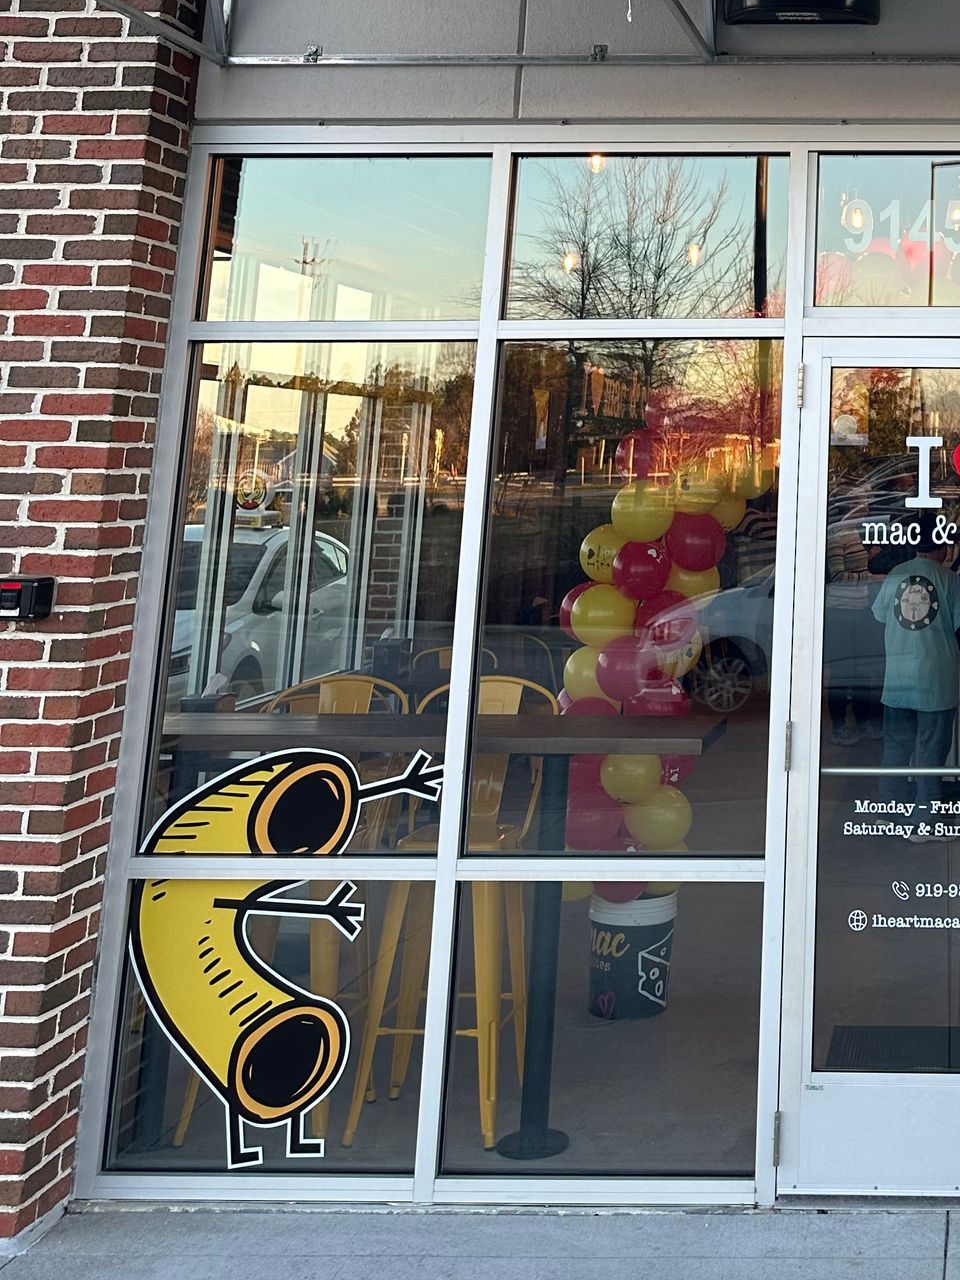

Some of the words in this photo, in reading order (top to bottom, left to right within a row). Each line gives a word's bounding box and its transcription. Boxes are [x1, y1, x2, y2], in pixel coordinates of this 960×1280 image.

[905, 436, 943, 509] I
[861, 521, 921, 546] mac
[931, 514, 957, 546] &
[854, 800, 915, 817] Monday
[843, 822, 914, 839] Saturday
[917, 823, 931, 836] &
